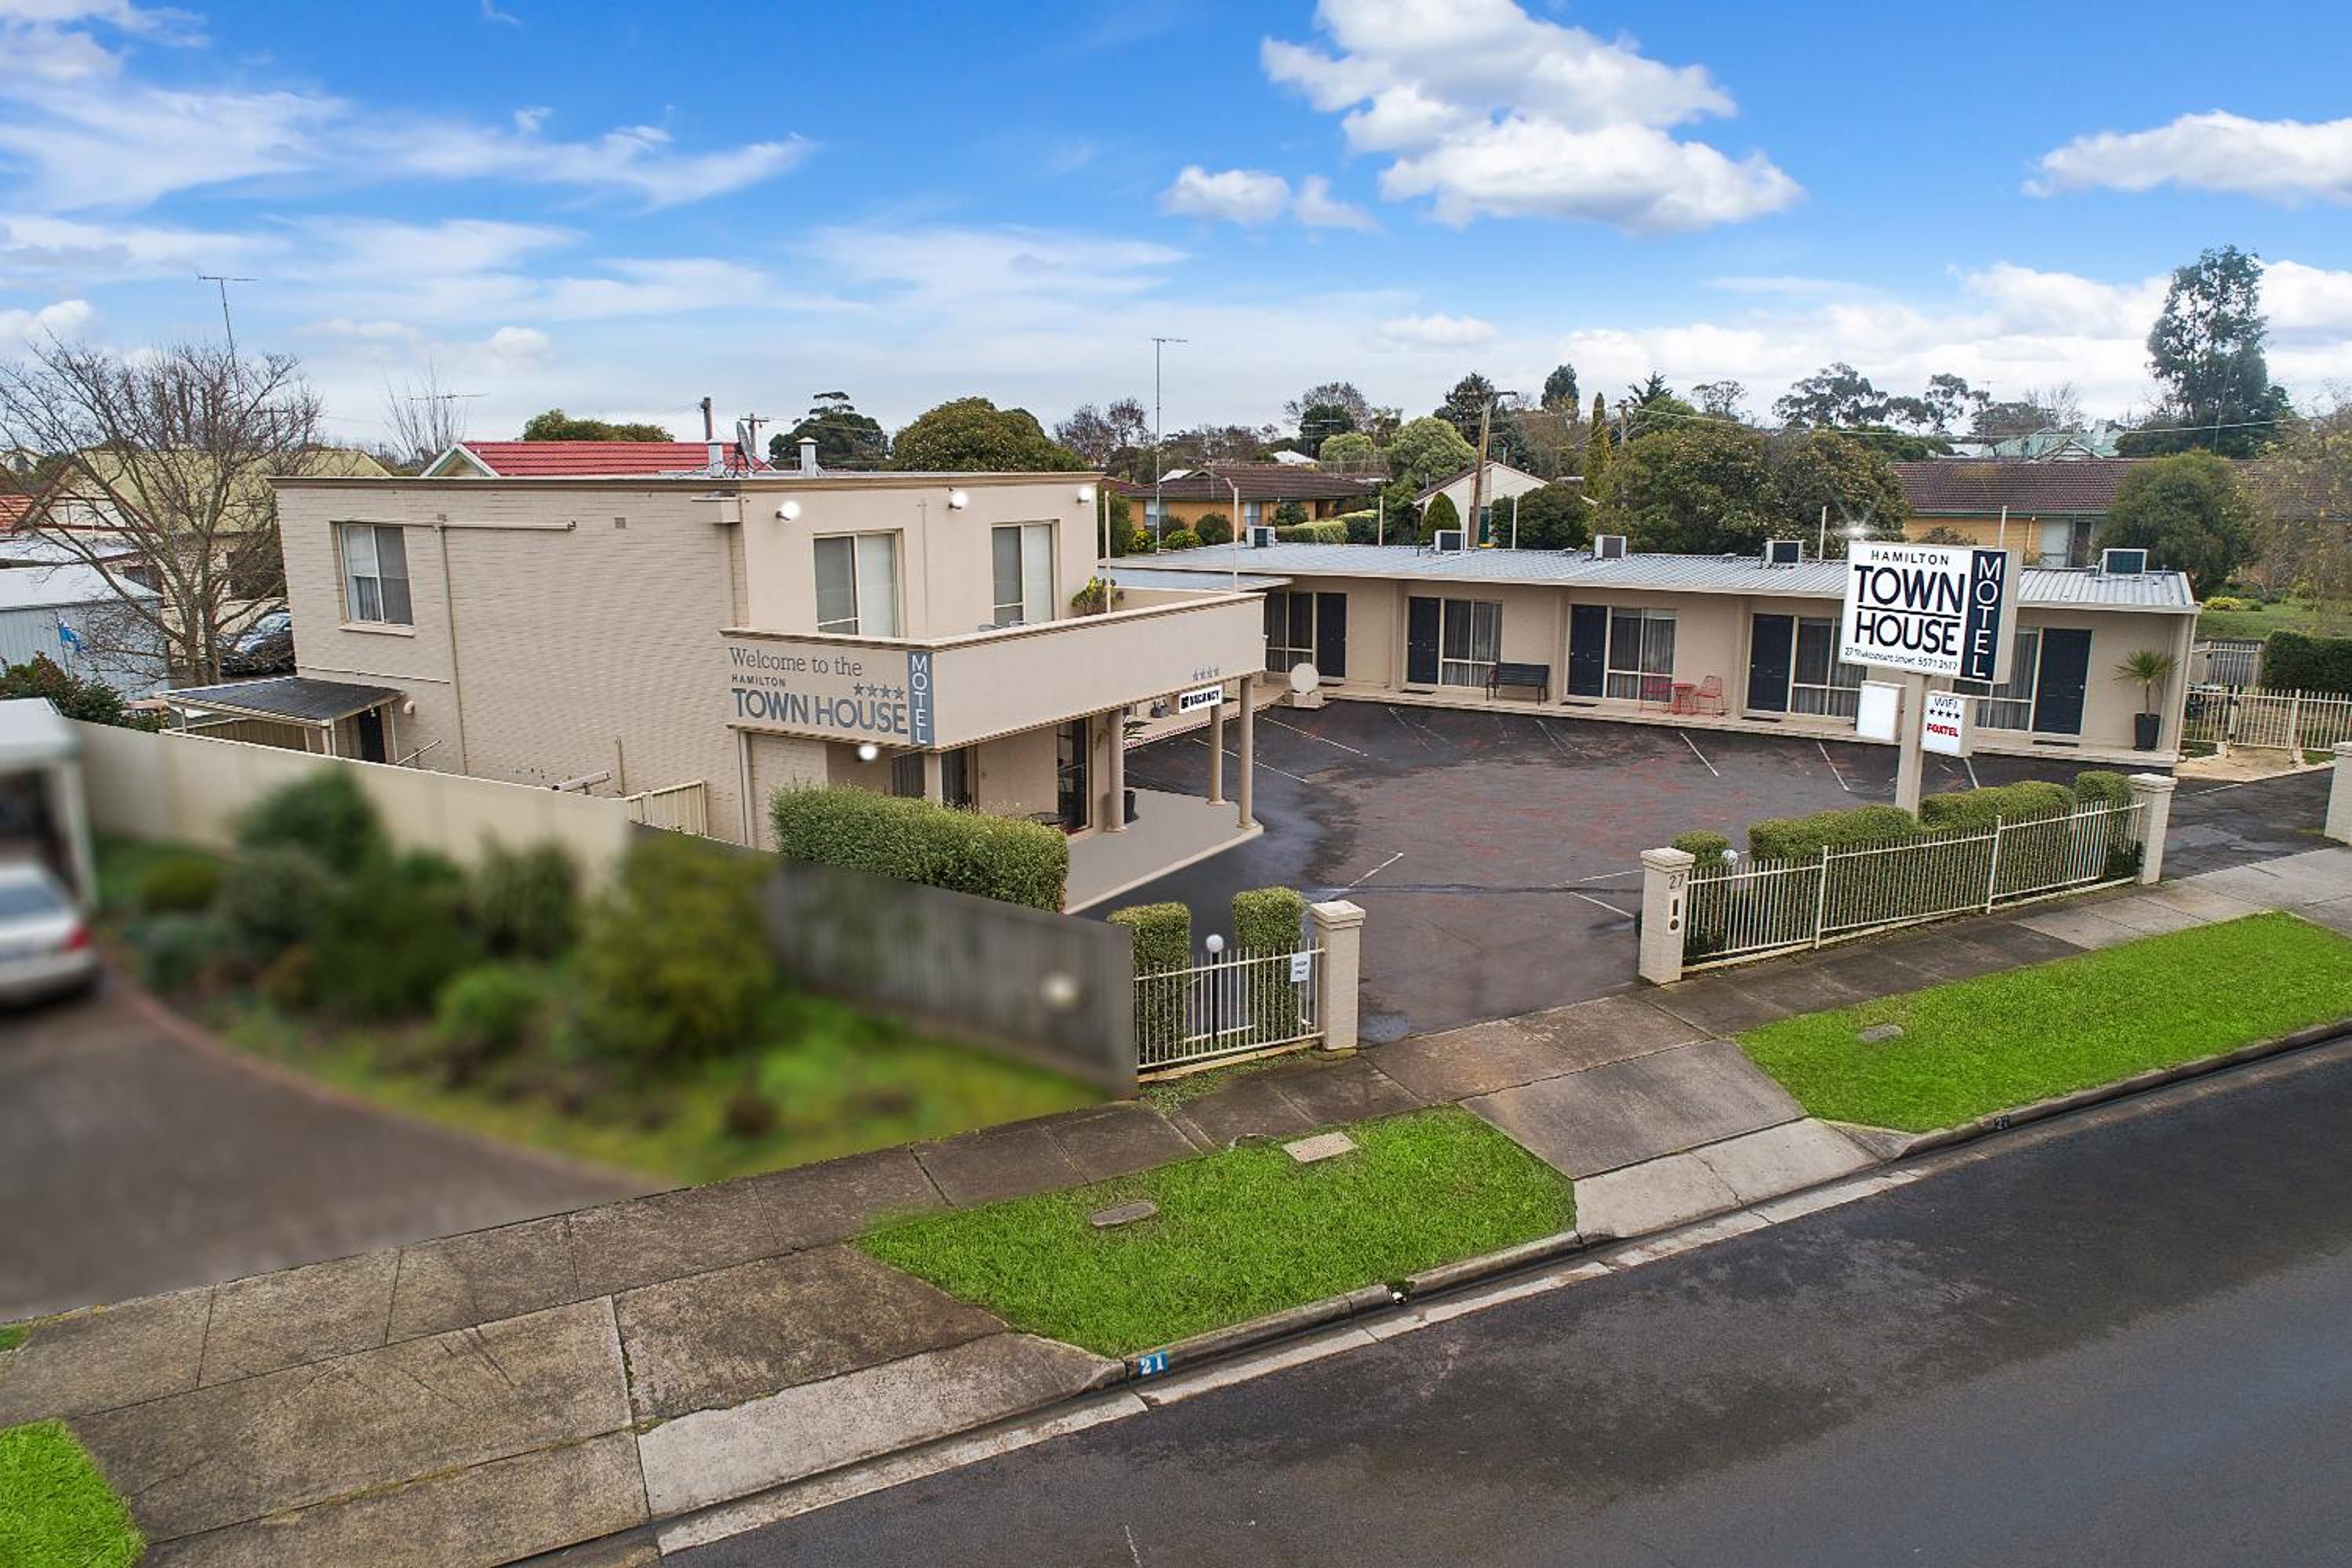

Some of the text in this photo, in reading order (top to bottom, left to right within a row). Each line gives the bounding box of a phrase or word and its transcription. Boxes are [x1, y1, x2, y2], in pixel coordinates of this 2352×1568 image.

[1871, 550, 1949, 565] HAMILTON
[1854, 564, 1965, 613] TOWN
[1972, 556, 2002, 677] MOTEL
[1855, 611, 1961, 655] HOUSE
[1845, 647, 1853, 656] 27
[728, 647, 862, 677] Welcome to the
[731, 674, 786, 688] HAMILTON
[912, 655, 928, 744] MOTEL
[1189, 690, 1220, 706] VACANCY
[1934, 697, 1958, 709] WIFI
[731, 688, 908, 735] TOWN HOUSE
[1926, 723, 1959, 737] FOXTEL
[1669, 872, 1685, 890] 27
[1141, 1354, 1164, 1374] 21
